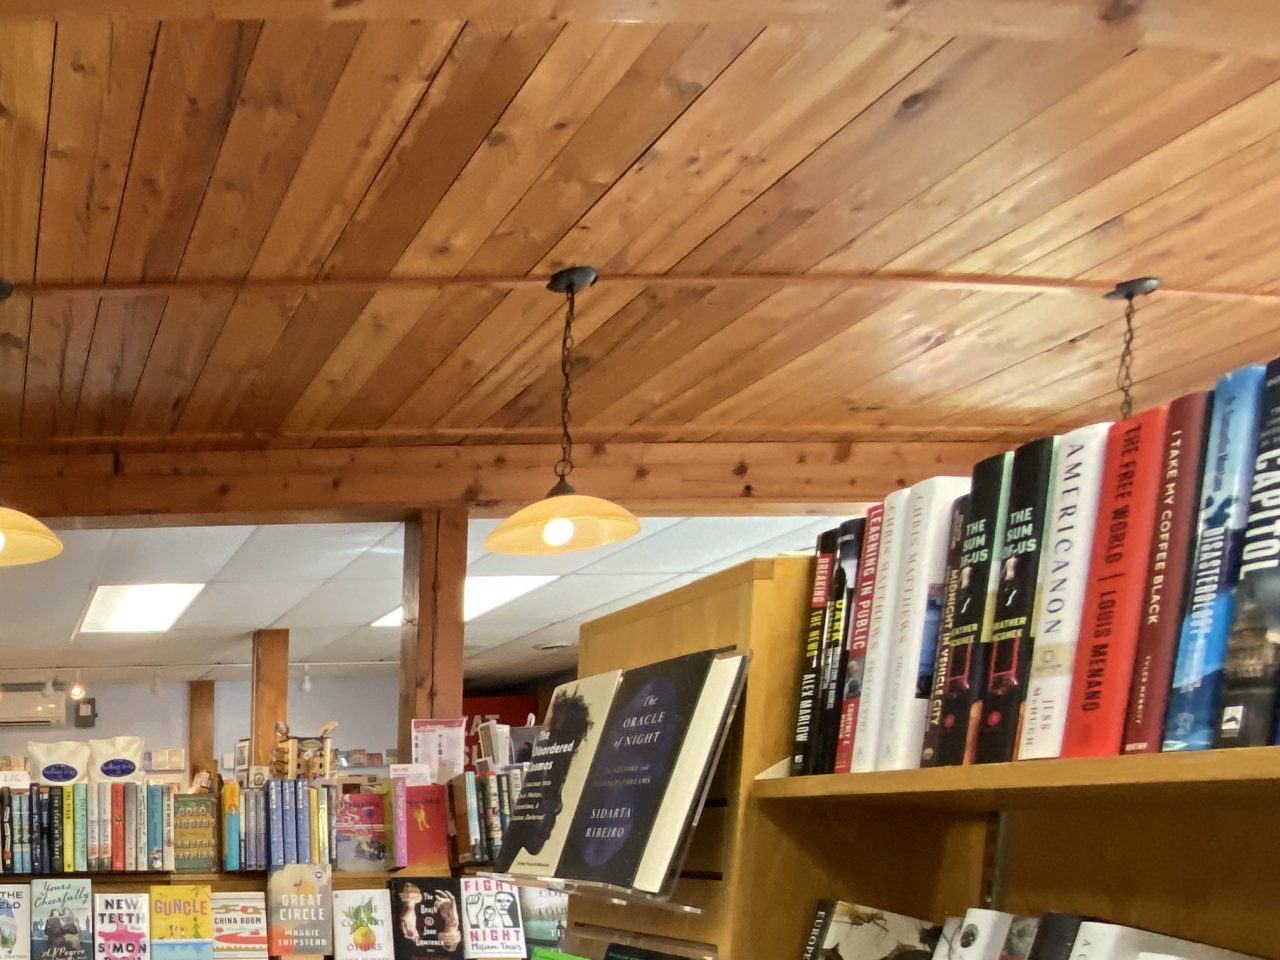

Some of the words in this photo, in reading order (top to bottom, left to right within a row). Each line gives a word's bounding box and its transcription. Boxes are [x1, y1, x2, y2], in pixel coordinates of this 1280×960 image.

[1010, 507, 1033, 523] THE
[1239, 448, 1280, 580] CAPITOL
[966, 519, 986, 534] THE
[1006, 524, 1032, 542] SUM
[861, 507, 883, 583] LEARNING
[963, 534, 985, 552] SUM
[1043, 443, 1085, 636] AMERICANON
[1152, 508, 1172, 571] COFFEE
[812, 557, 830, 605] BREAKING
[941, 569, 960, 628] MIDNIGHT
[1147, 574, 1168, 625] BLACK
[1099, 587, 1117, 640] LOUIS
[853, 601, 871, 650] PUBLIC
[642, 695, 658, 706] The
[623, 711, 666, 729] ORACLE
[795, 699, 812, 742] MARLOW
[624, 731, 661, 746] NIGHT
[532, 741, 574, 757] Disordered
[179, 806, 207, 816] GOLD
[591, 808, 631, 819] SIDARTA
[585, 827, 625, 838] RIBEIRO
[42, 881, 71, 892] Yours
[464, 879, 518, 892] FIGHT
[0, 891, 23, 899] THE
[34, 891, 90, 908] Cheerfully
[281, 894, 322, 907] GREAT
[104, 899, 139, 910] NEW
[155, 900, 208, 917] GUNCLE
[98, 913, 145, 924] TEETH
[214, 917, 238, 925] CHINA
[240, 917, 262, 925] ROOM
[279, 908, 325, 921] CIRCLE
[284, 929, 319, 937] MAGGIE
[470, 930, 521, 942] NIGHT
[98, 942, 147, 954] SIMON
[278, 938, 327, 947] SHIPSTEAD
